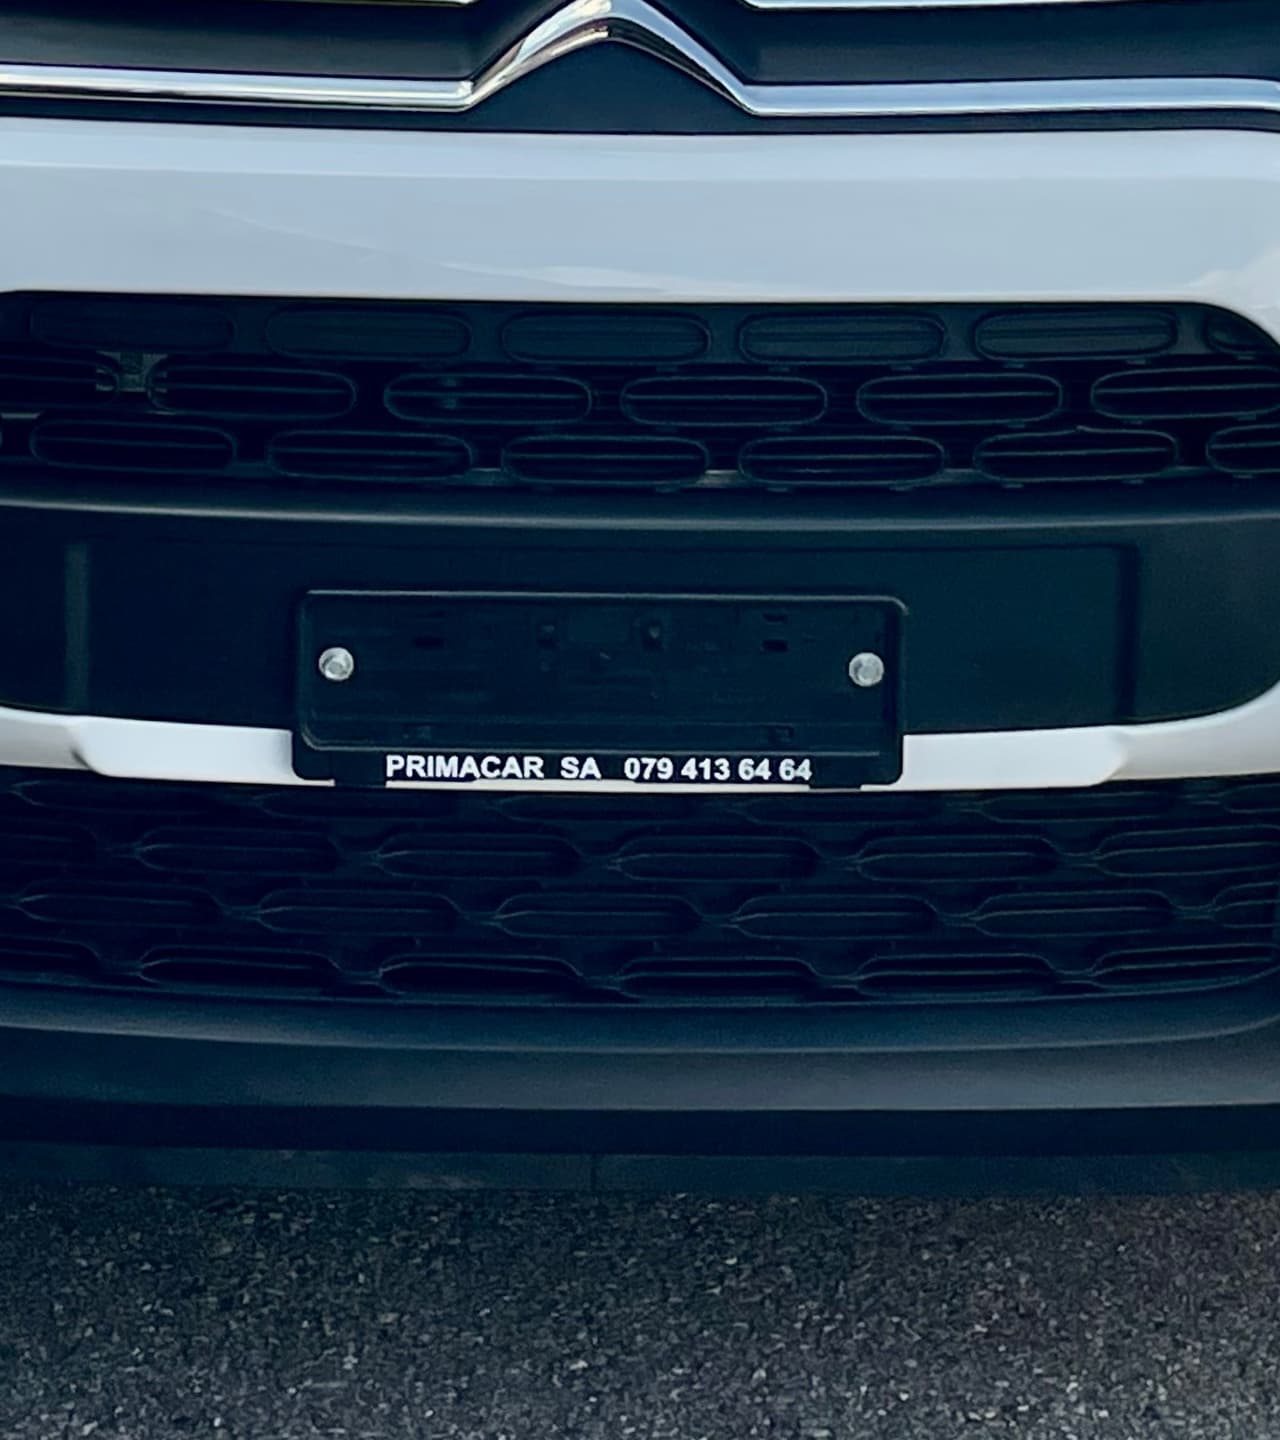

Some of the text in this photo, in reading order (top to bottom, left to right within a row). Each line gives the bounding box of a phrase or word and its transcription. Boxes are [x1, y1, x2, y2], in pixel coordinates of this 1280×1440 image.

[385, 754, 813, 781] PRIMACAR SA 079 413 64 64
